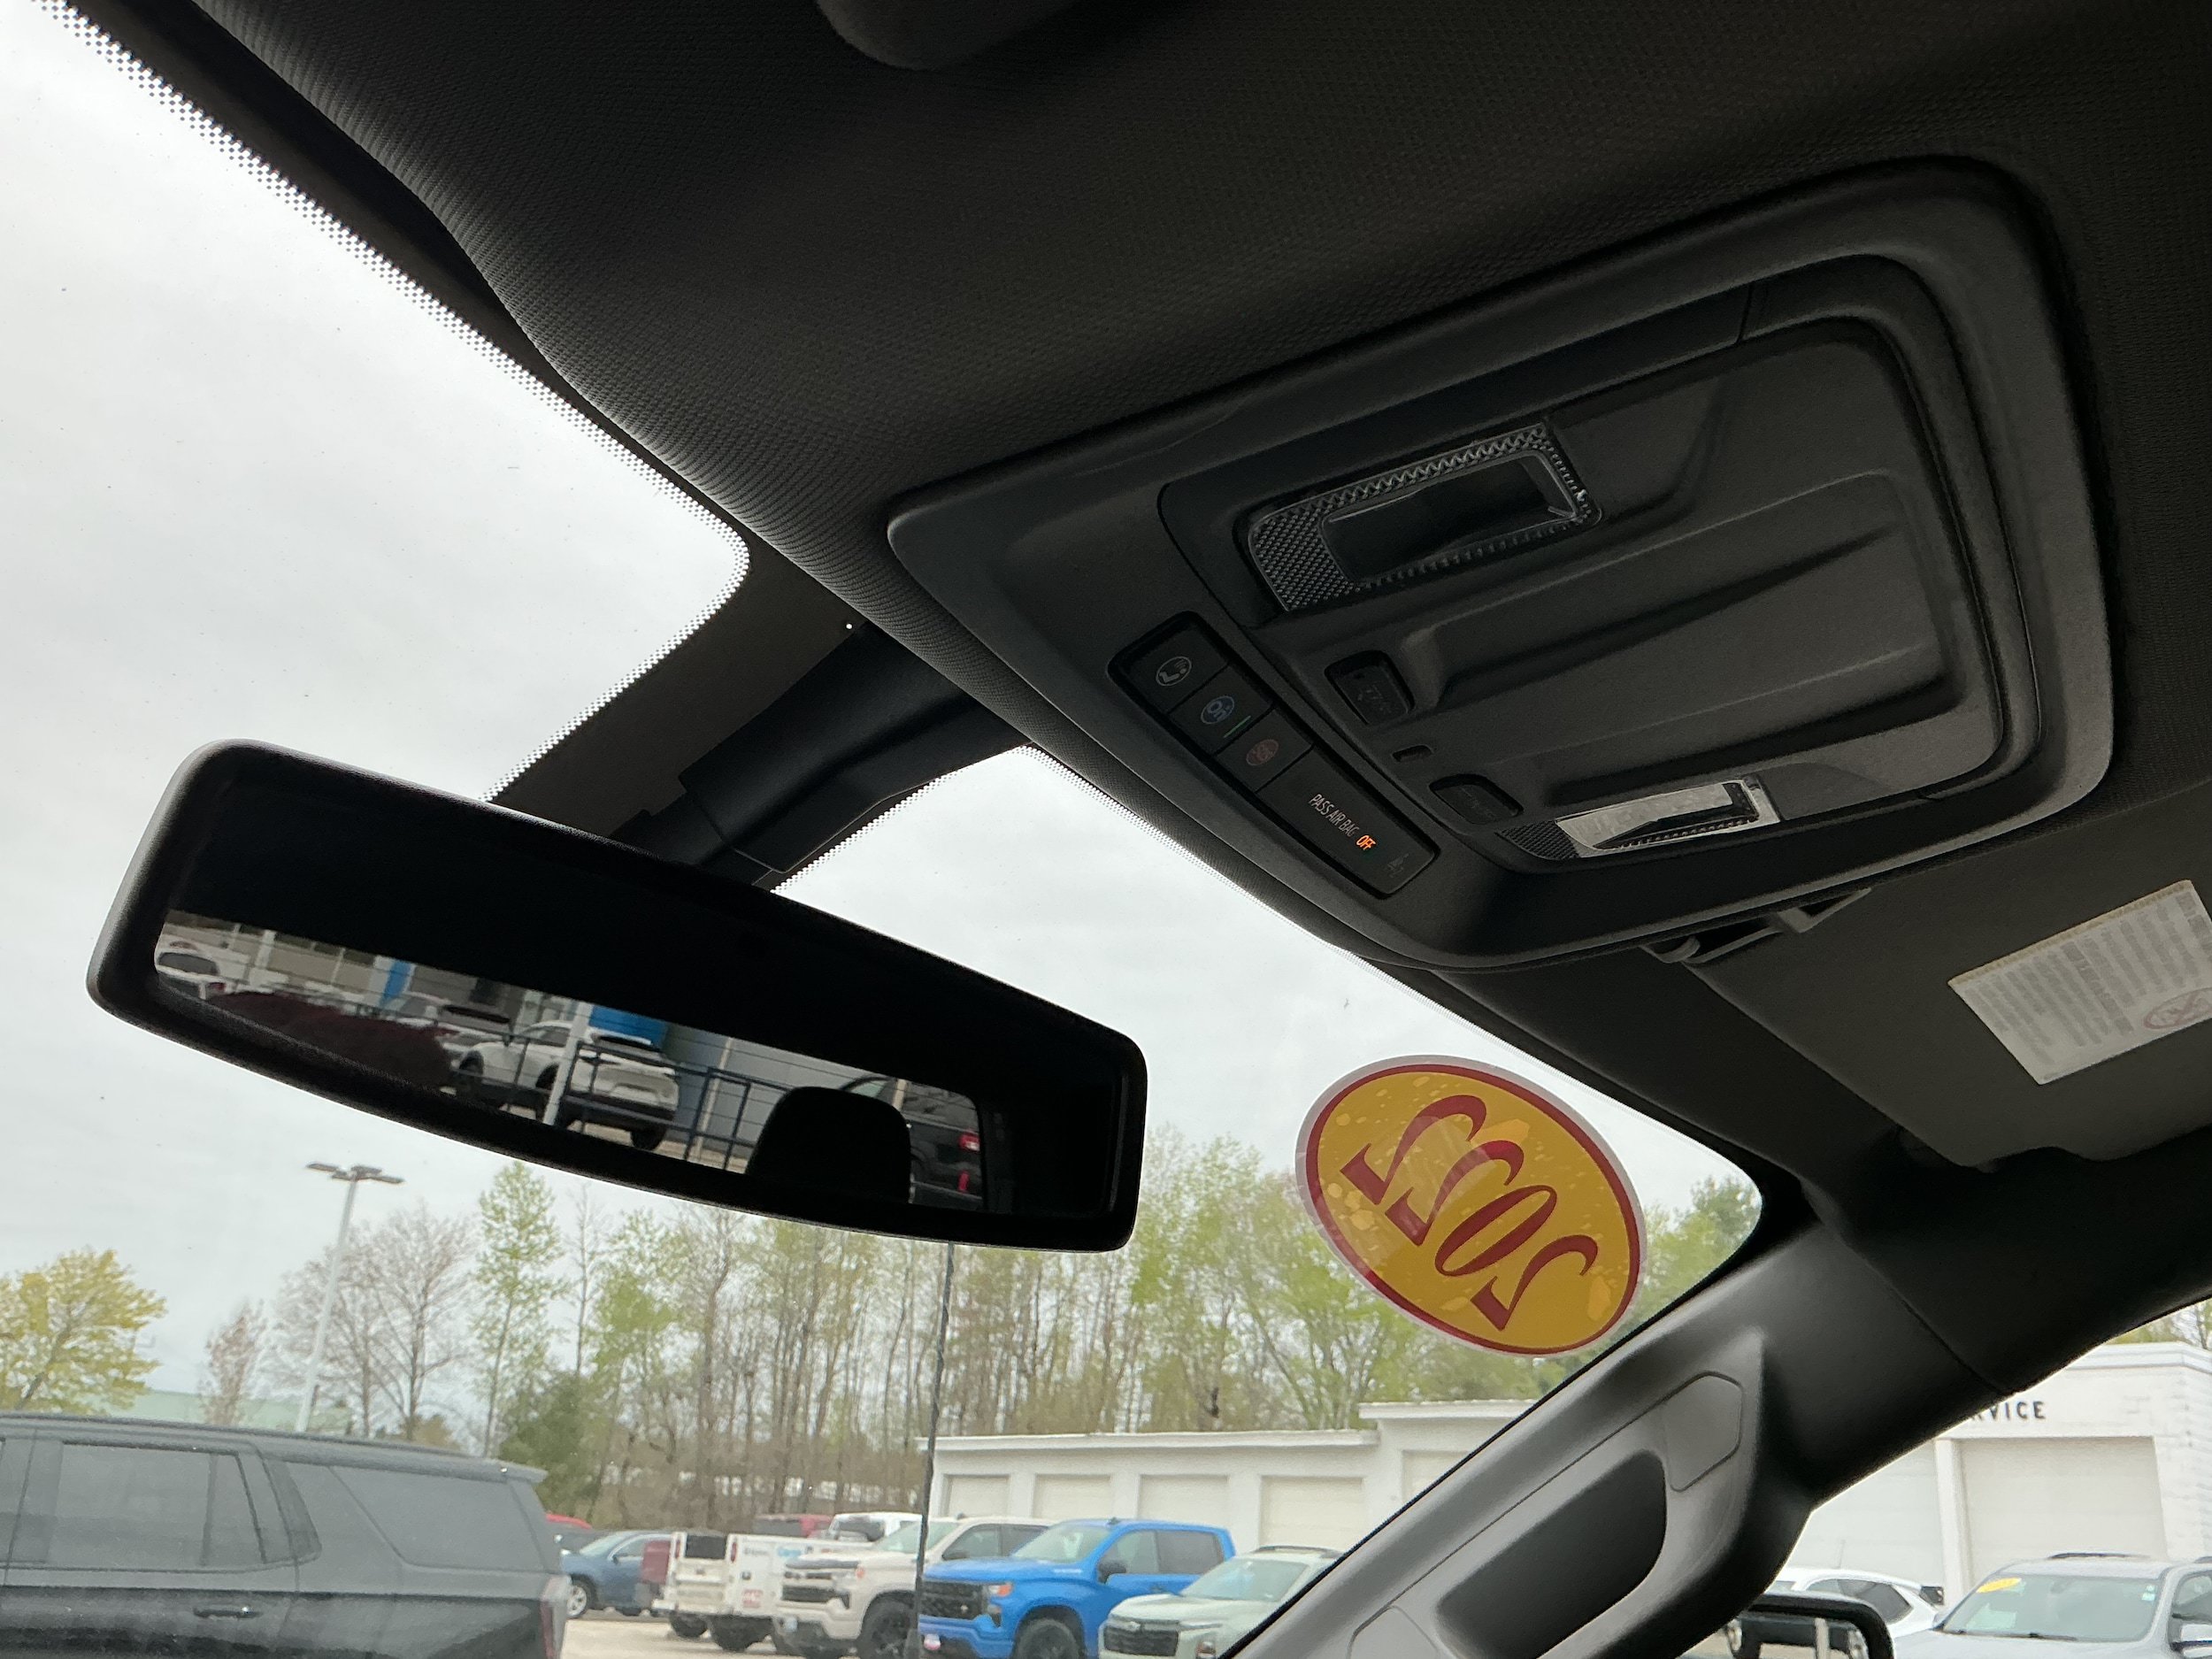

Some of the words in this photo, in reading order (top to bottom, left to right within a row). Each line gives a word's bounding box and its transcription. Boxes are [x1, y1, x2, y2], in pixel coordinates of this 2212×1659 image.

[1309, 794, 1334, 816] PASS
[1325, 809, 1346, 826] AIR
[1338, 818, 1360, 838] BAG
[1356, 834, 1377, 851] OFF
[1970, 1400, 2047, 1421] VICE
